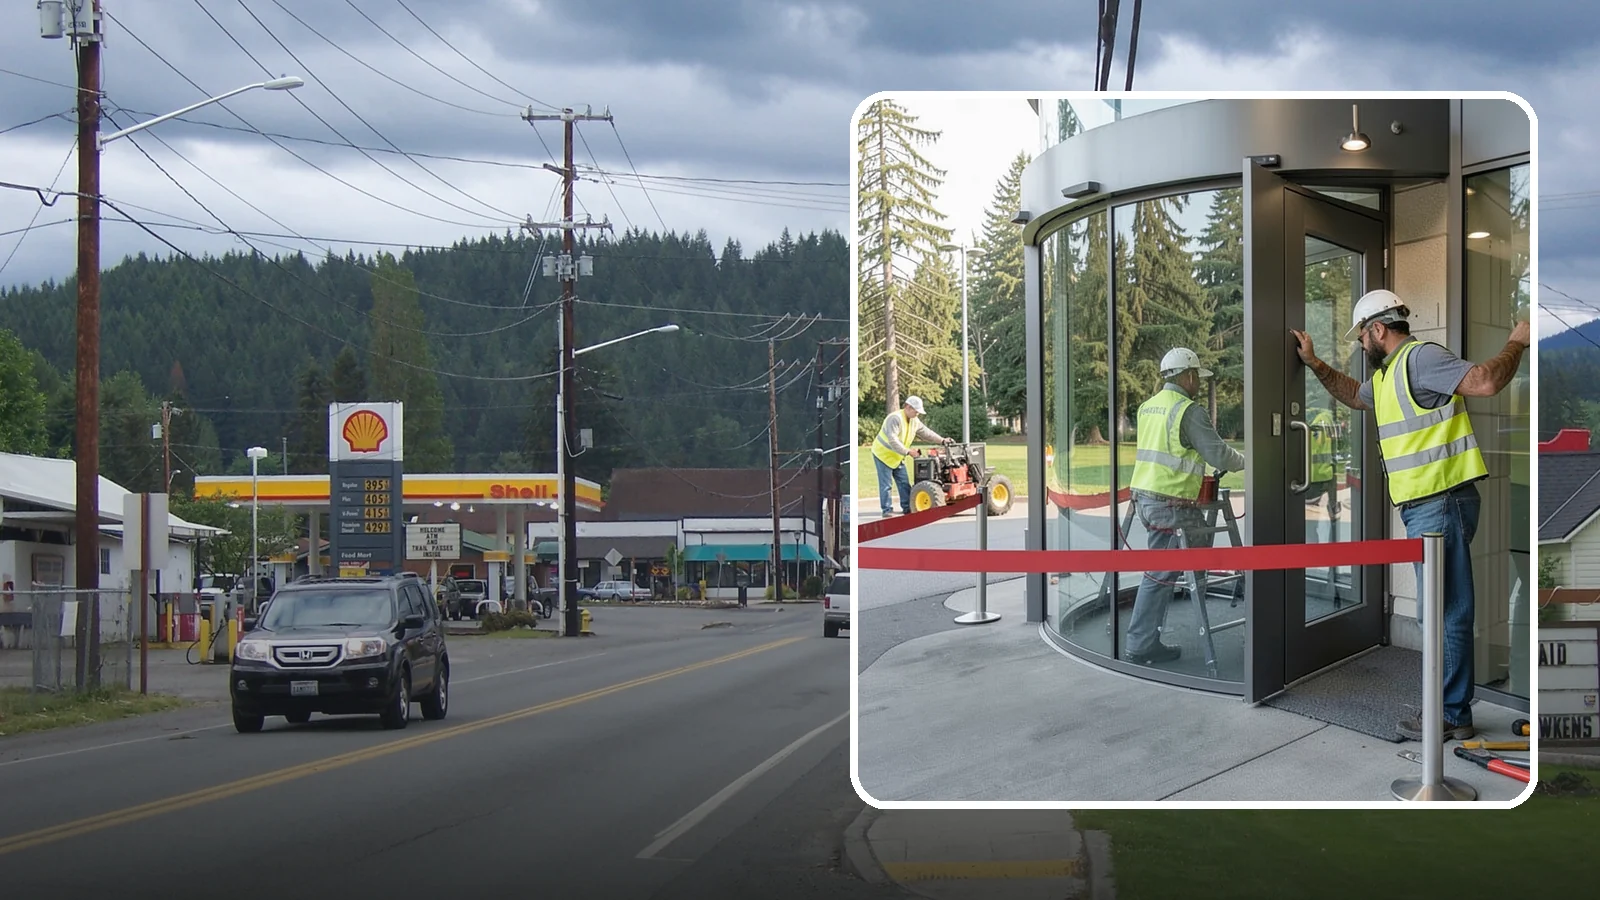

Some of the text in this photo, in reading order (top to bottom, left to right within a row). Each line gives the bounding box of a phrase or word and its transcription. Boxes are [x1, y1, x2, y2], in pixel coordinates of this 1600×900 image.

[365, 480, 383, 490] 395
[490, 484, 547, 499] Shell
[365, 494, 383, 504] 405
[365, 508, 383, 518] 415
[366, 522, 383, 533] 429
